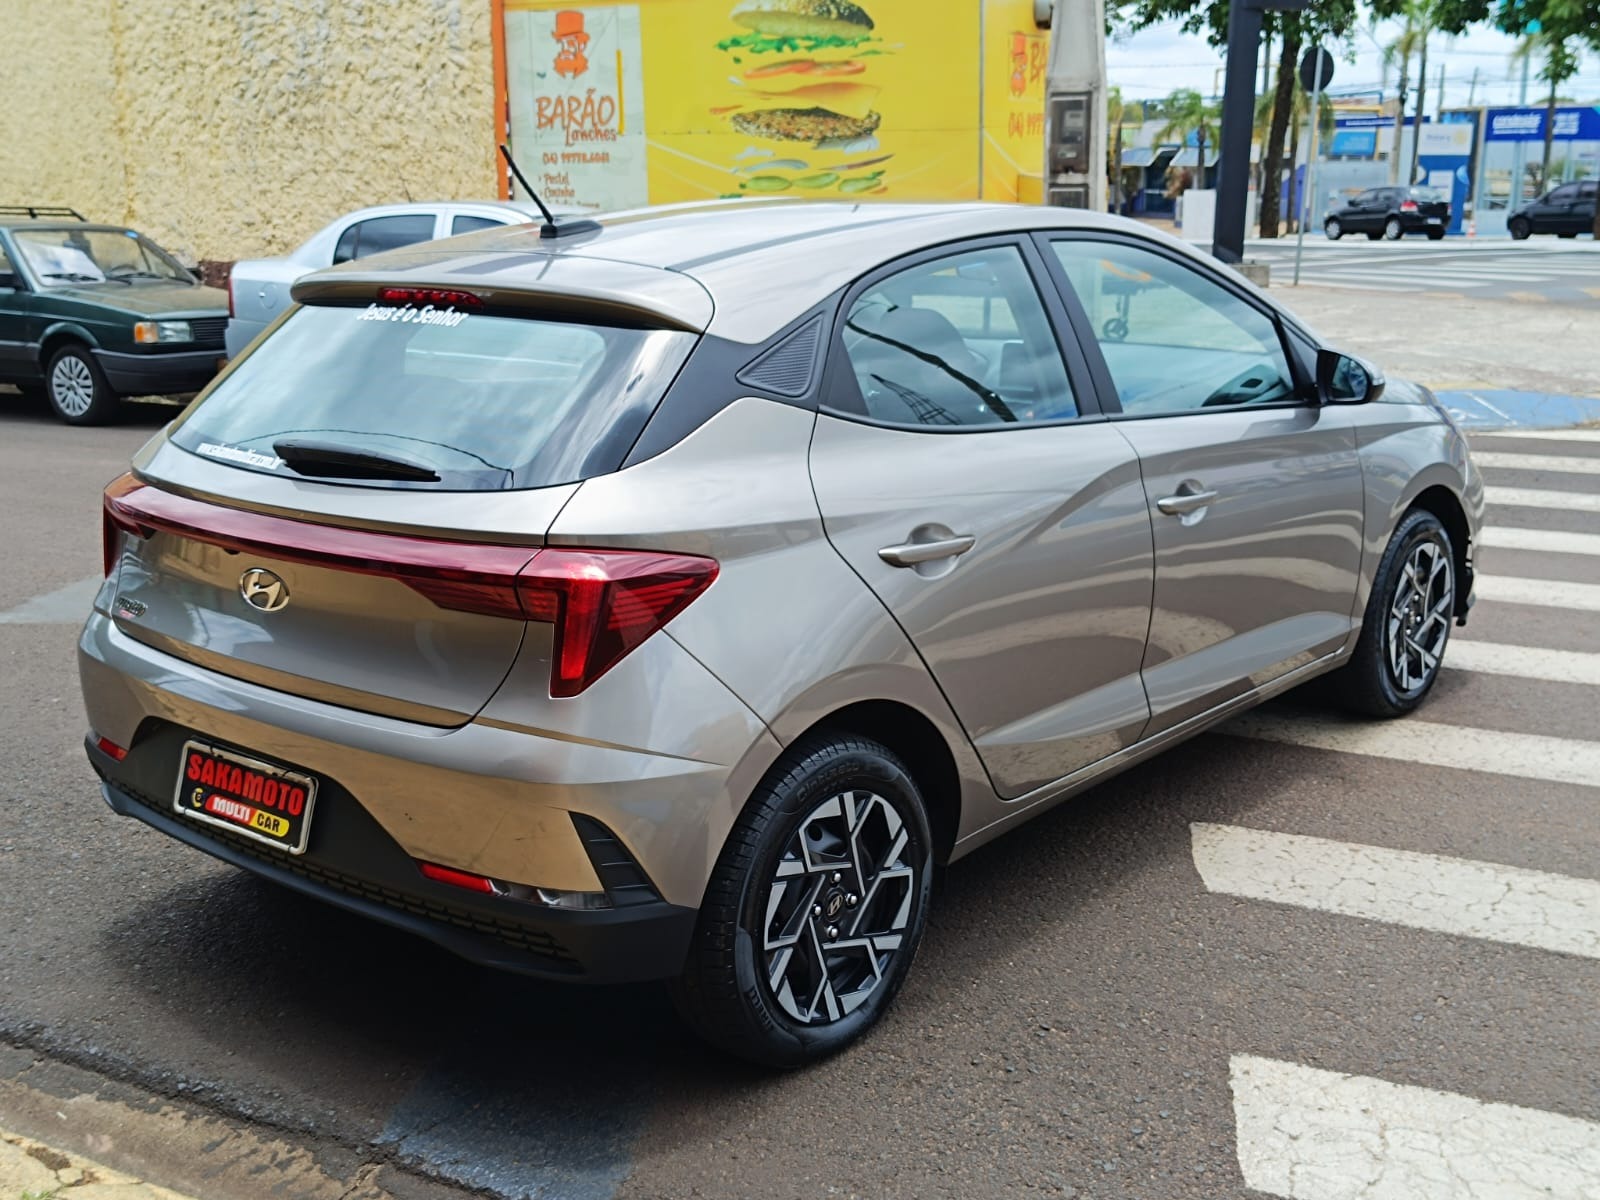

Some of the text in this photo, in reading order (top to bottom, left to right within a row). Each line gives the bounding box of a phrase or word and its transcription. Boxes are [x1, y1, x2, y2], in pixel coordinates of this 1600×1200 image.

[536, 88, 615, 130] BARÃO
[356, 303, 398, 321] Jesus
[401, 308, 418, 323] o
[412, 304, 470, 328] Senhor
[187, 753, 305, 817] SAKAMOTO
[212, 796, 251, 823] MULTI
[256, 812, 281, 834] CAR
